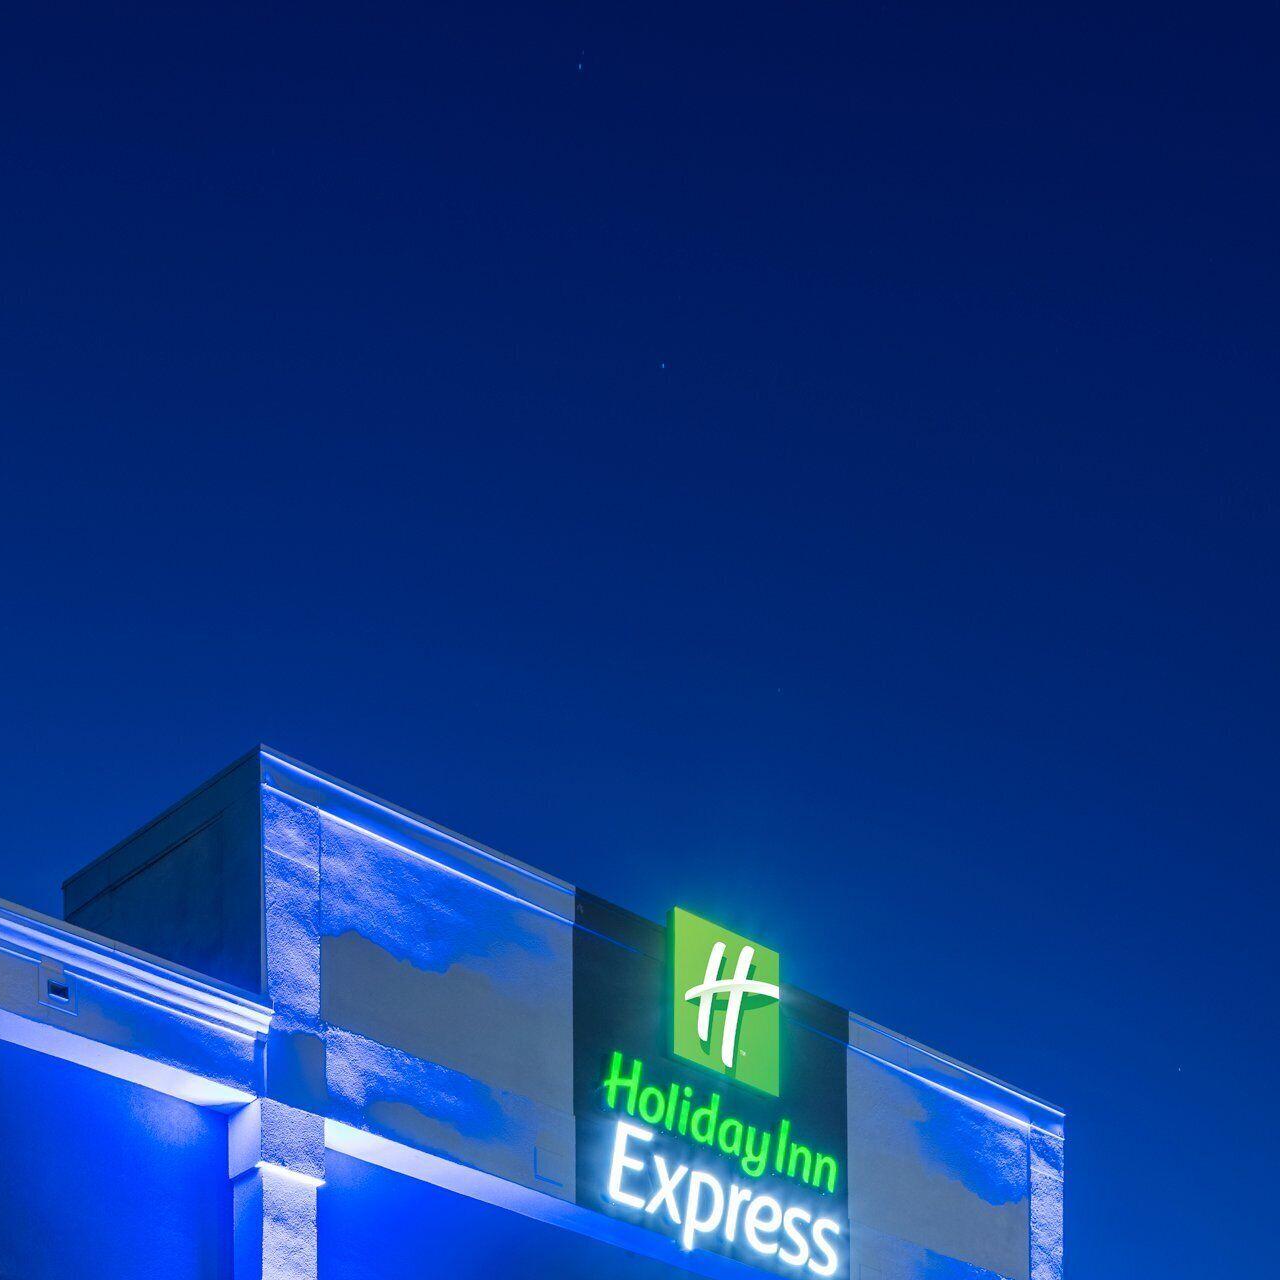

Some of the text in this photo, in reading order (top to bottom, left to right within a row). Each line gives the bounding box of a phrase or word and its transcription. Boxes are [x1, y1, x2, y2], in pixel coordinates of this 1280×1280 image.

[603, 1051, 838, 1193] Holiday Inn
[608, 1121, 841, 1277] Express
